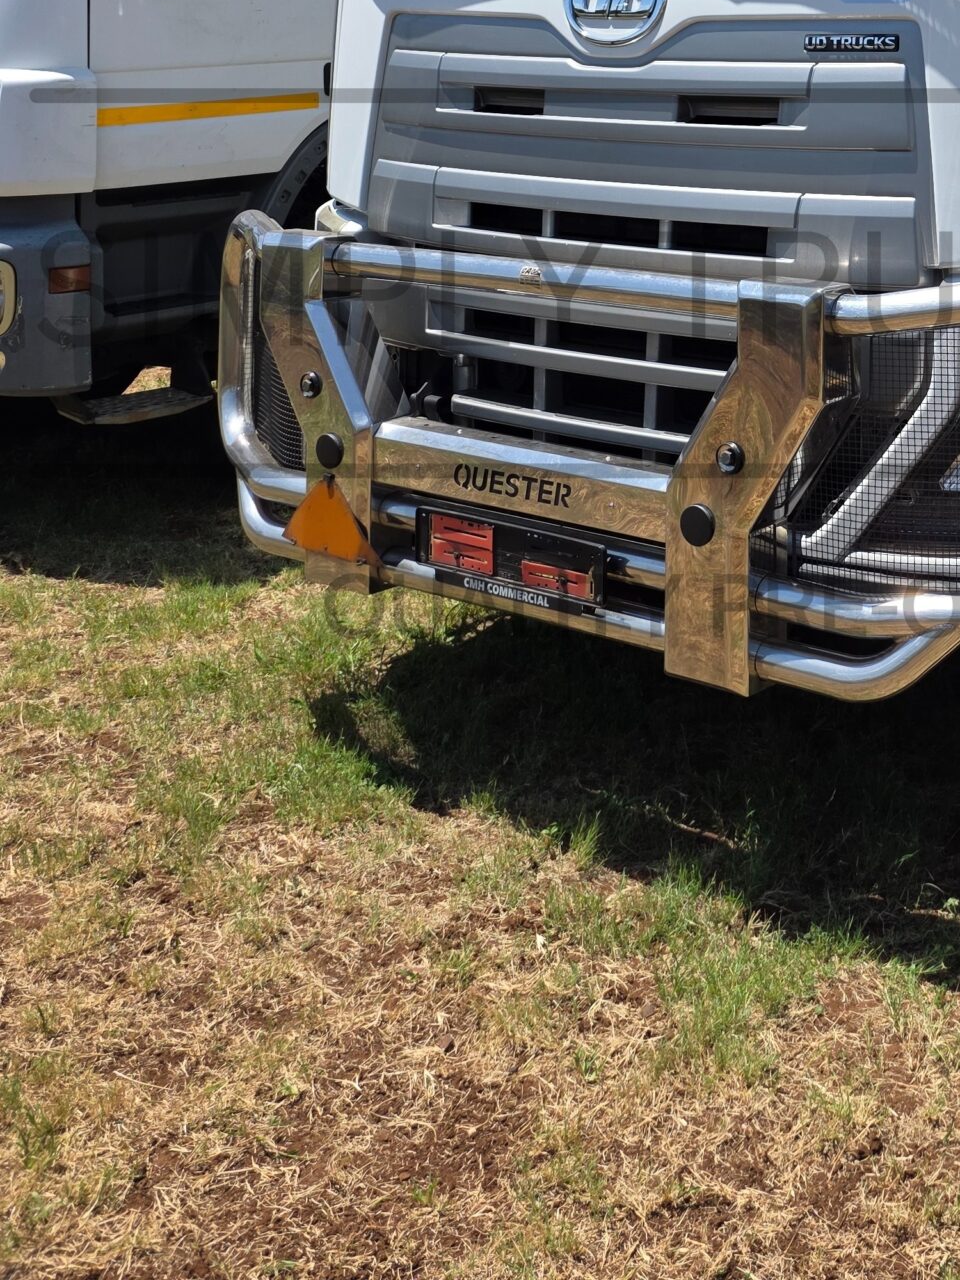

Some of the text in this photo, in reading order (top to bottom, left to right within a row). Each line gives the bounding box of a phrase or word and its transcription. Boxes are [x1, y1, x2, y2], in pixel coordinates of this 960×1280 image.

[804, 35, 897, 50] UD TRUCKS
[453, 463, 572, 508] QUESTER
[463, 577, 550, 608] CMH COMMERCIAL
